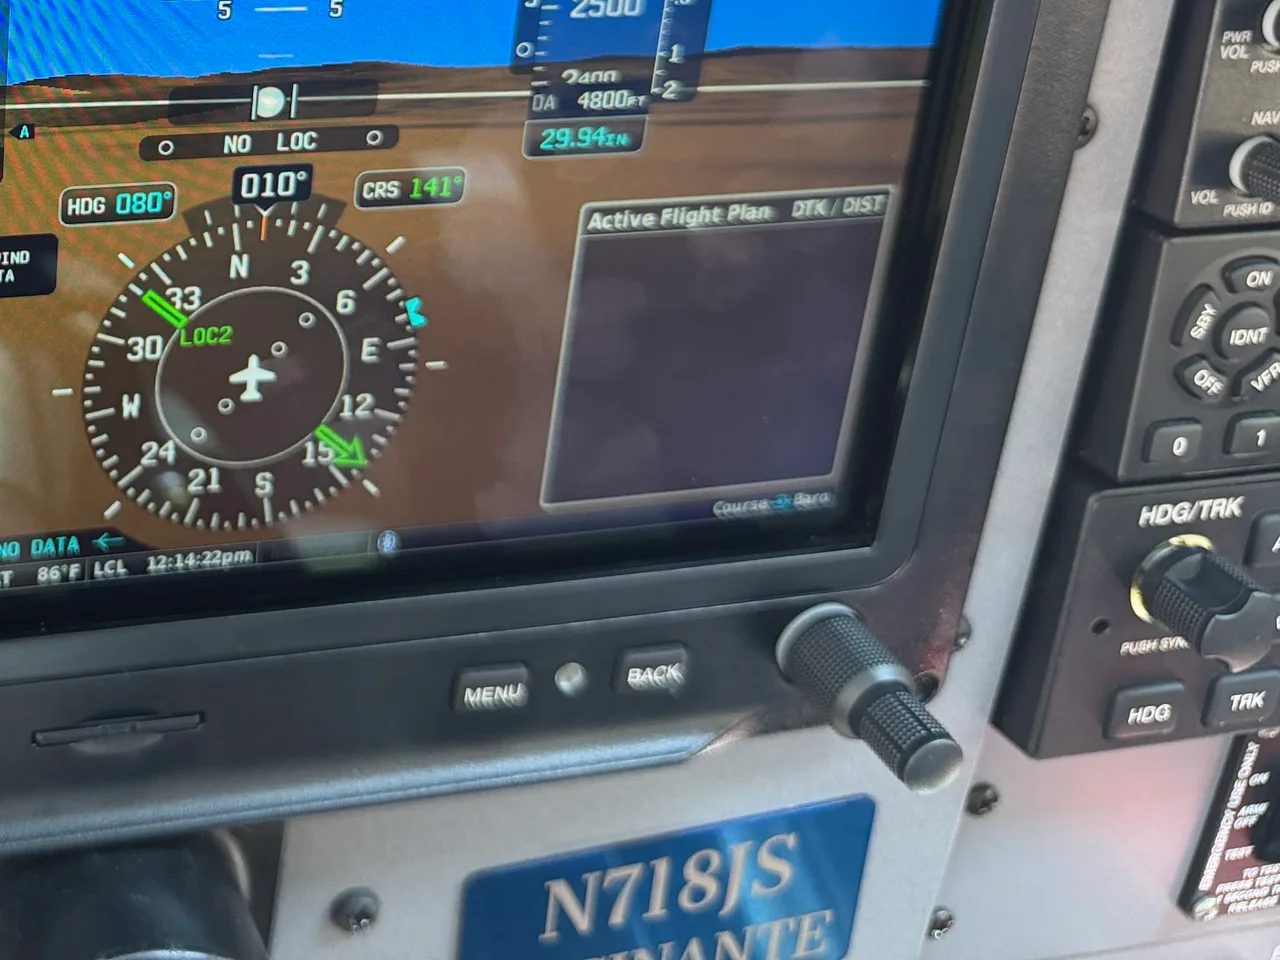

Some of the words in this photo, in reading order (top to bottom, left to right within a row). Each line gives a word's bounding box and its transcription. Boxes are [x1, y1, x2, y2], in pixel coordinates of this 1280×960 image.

[218, 0, 232, 20] 5
[1222, 30, 1254, 43] PWR
[668, 44, 686, 63] 1
[1220, 44, 1249, 60] VOL
[561, 69, 620, 85] 2400
[661, 80, 684, 99] 2
[532, 94, 558, 111] DA
[1251, 111, 1280, 126] NAV
[20, 125, 29, 138] A
[224, 135, 251, 154] NO
[277, 131, 317, 151] LOC
[362, 181, 401, 200] CRS
[1191, 190, 1219, 205] VOL
[67, 197, 105, 216] HDG
[587, 210, 658, 233] Active
[660, 205, 723, 229] Flight
[727, 203, 774, 223] Plan
[1223, 203, 1257, 217] PUSH
[1259, 202, 1274, 215] ID
[230, 254, 249, 279] N
[291, 260, 310, 285] 3
[1246, 270, 1272, 288] ON
[166, 286, 202, 311] 33
[336, 290, 356, 315] 6
[1190, 303, 1219, 340] SBY
[180, 325, 233, 347] LOC2
[1229, 326, 1270, 346] IDNT
[127, 335, 162, 361] 30
[361, 337, 380, 363] E
[1194, 368, 1225, 397] OFF
[1250, 361, 1280, 393] VFR
[122, 393, 141, 419] W
[339, 393, 376, 420] 12
[1172, 436, 1189, 457] 0
[1256, 428, 1267, 447] 1
[141, 440, 176, 467] 24
[302, 442, 335, 468] 15
[188, 467, 221, 495] 21
[255, 471, 274, 497] S
[713, 497, 770, 520] Course
[1138, 495, 1246, 528] HDG/TRK
[31, 536, 80, 556] DATA
[94, 559, 127, 578] LCL
[147, 549, 253, 573] 12:14:22pm
[1120, 639, 1158, 656] PUSH
[627, 662, 687, 690] BACK
[464, 682, 529, 710] MENU
[1230, 690, 1268, 712] TRK
[1127, 703, 1173, 726] HDG
[1249, 771, 1270, 788] ON
[1227, 779, 1248, 809] USE
[538, 832, 799, 945] N718JS
